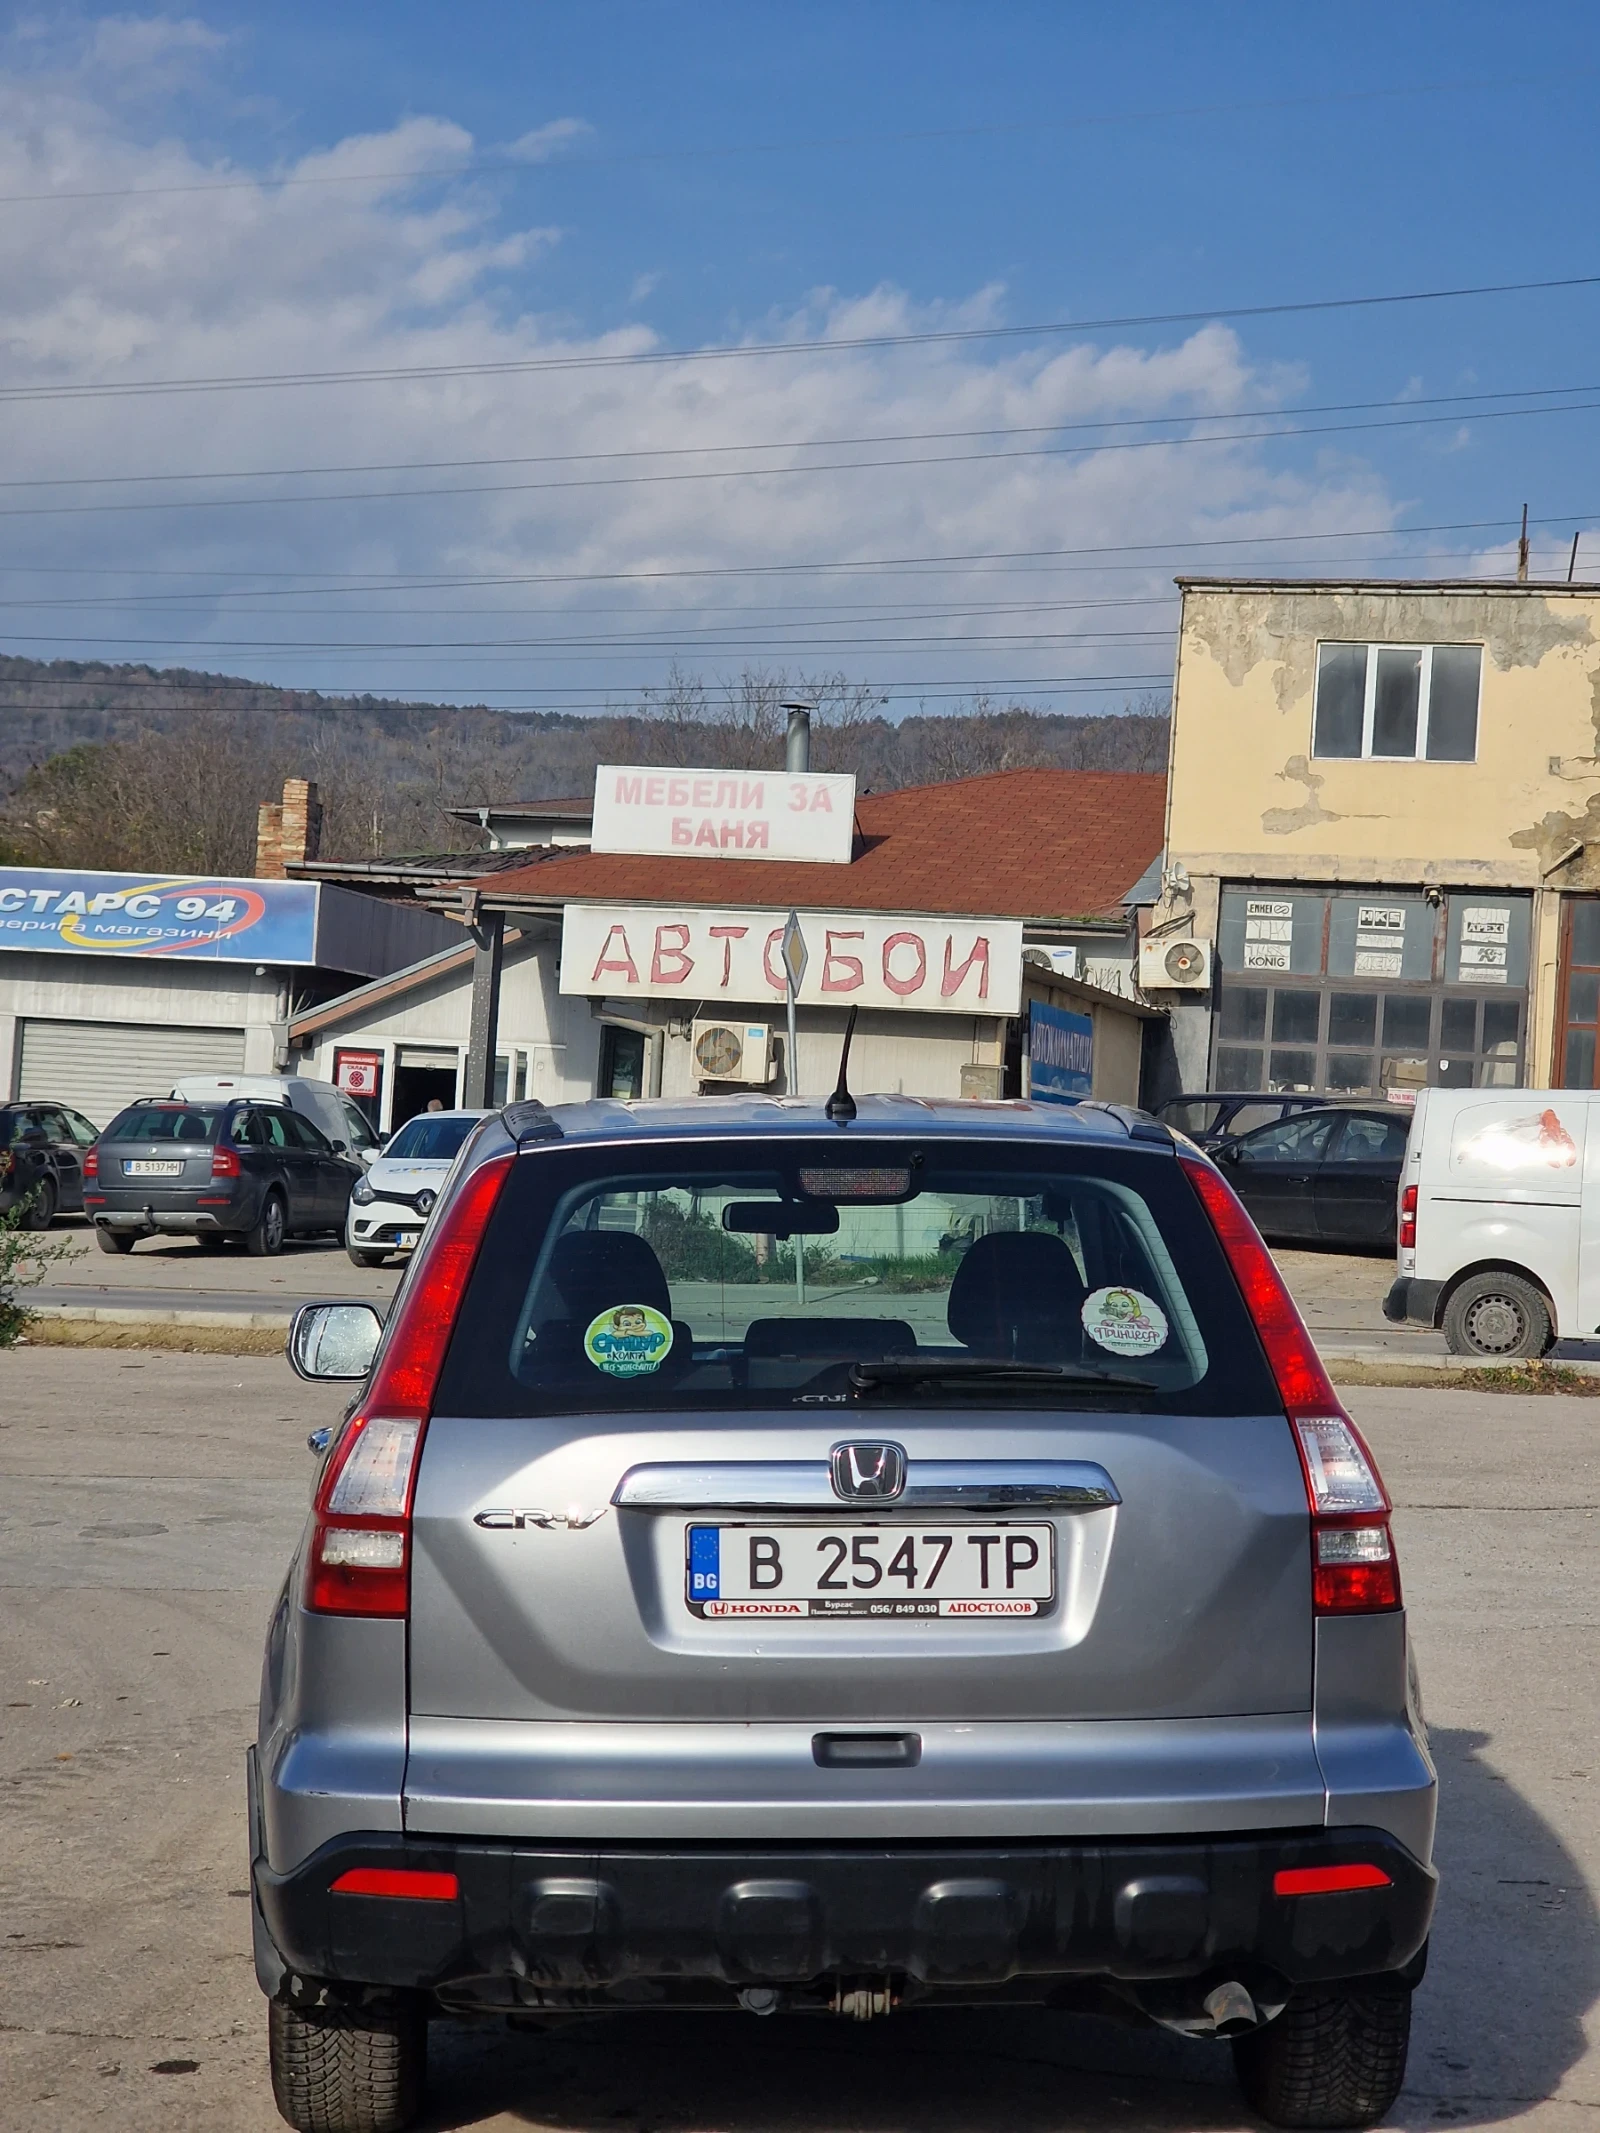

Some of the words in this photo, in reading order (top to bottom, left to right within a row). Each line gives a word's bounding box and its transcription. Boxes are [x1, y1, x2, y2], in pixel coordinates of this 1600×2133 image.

[615, 776, 764, 810] МЕБЕЛИ
[788, 783, 833, 813] ЗА
[672, 817, 769, 849] БАНЯ
[175, 898, 236, 922] 94
[1361, 910, 1401, 926] HKS
[94, 923, 233, 940] магазини
[135, 1163, 141, 1171] B
[145, 1163, 165, 1171] 5137
[472, 1508, 608, 1530] CR-V
[750, 1536, 783, 1590] B
[817, 1536, 953, 1590] 2547
[967, 1536, 1039, 1590] TP
[694, 1573, 717, 1589] BG
[732, 1604, 802, 1613] HONDA
[870, 1604, 894, 1614] 056/
[896, 1604, 915, 1613] 849
[918, 1604, 936, 1613] 030
[948, 1603, 1031, 1612] АПОСТОЛОВ
